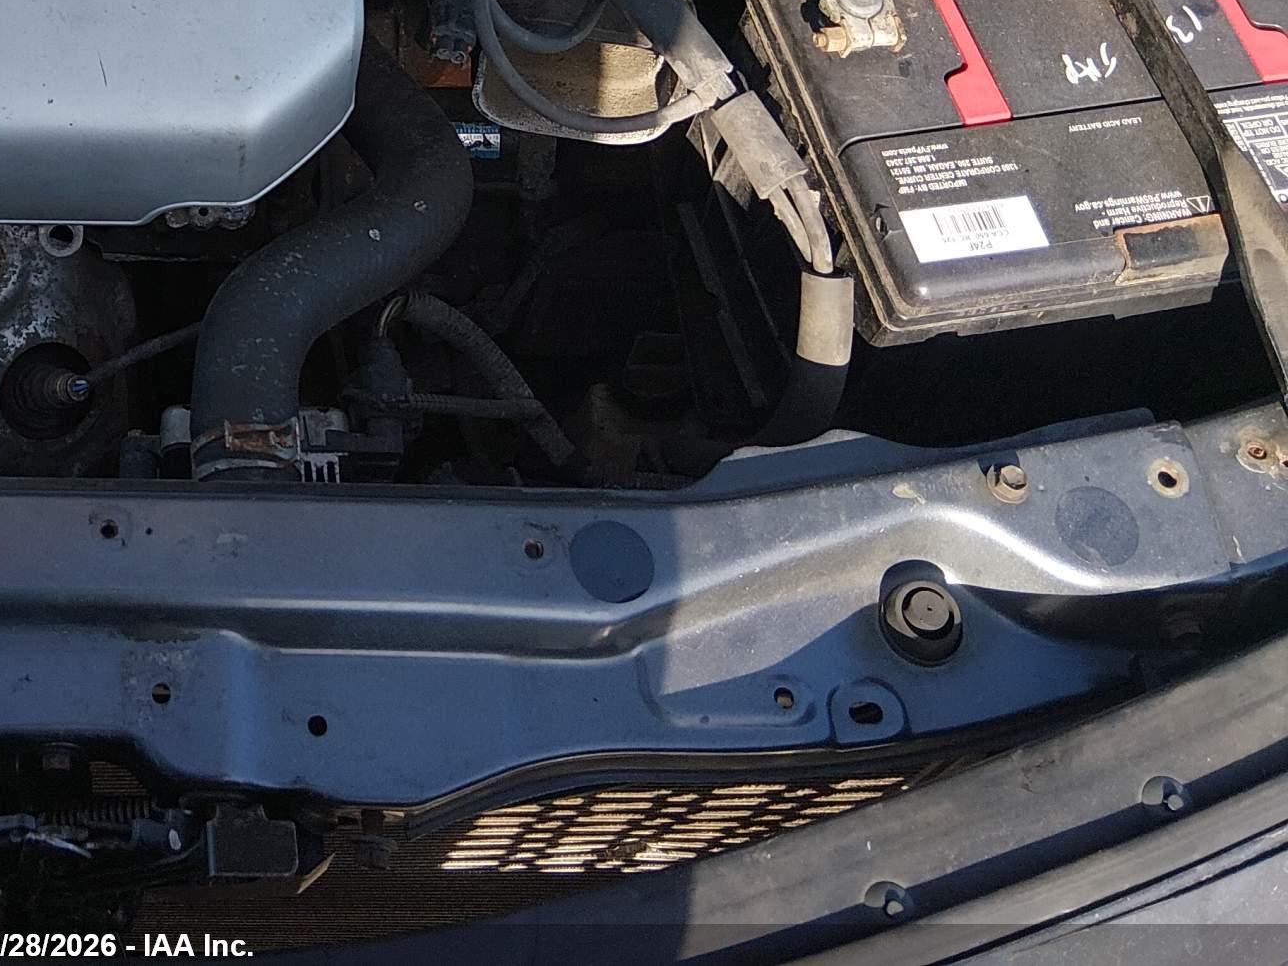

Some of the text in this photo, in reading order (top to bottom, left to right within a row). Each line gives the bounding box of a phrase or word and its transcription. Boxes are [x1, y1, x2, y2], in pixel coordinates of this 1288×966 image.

[1068, 116, 1142, 133] LEAD ACID BATTERY
[972, 157, 993, 165] SUITE
[925, 171, 955, 181] CENTER
[955, 165, 999, 177] CORPORATE
[929, 179, 967, 190] IMPORTED
[1074, 190, 1182, 213] www.P65Warnings.ca.gov
[1131, 198, 1188, 215] Reproductive
[1106, 204, 1130, 215] Harm
[1093, 208, 1193, 229] WARNING: Cancer and
